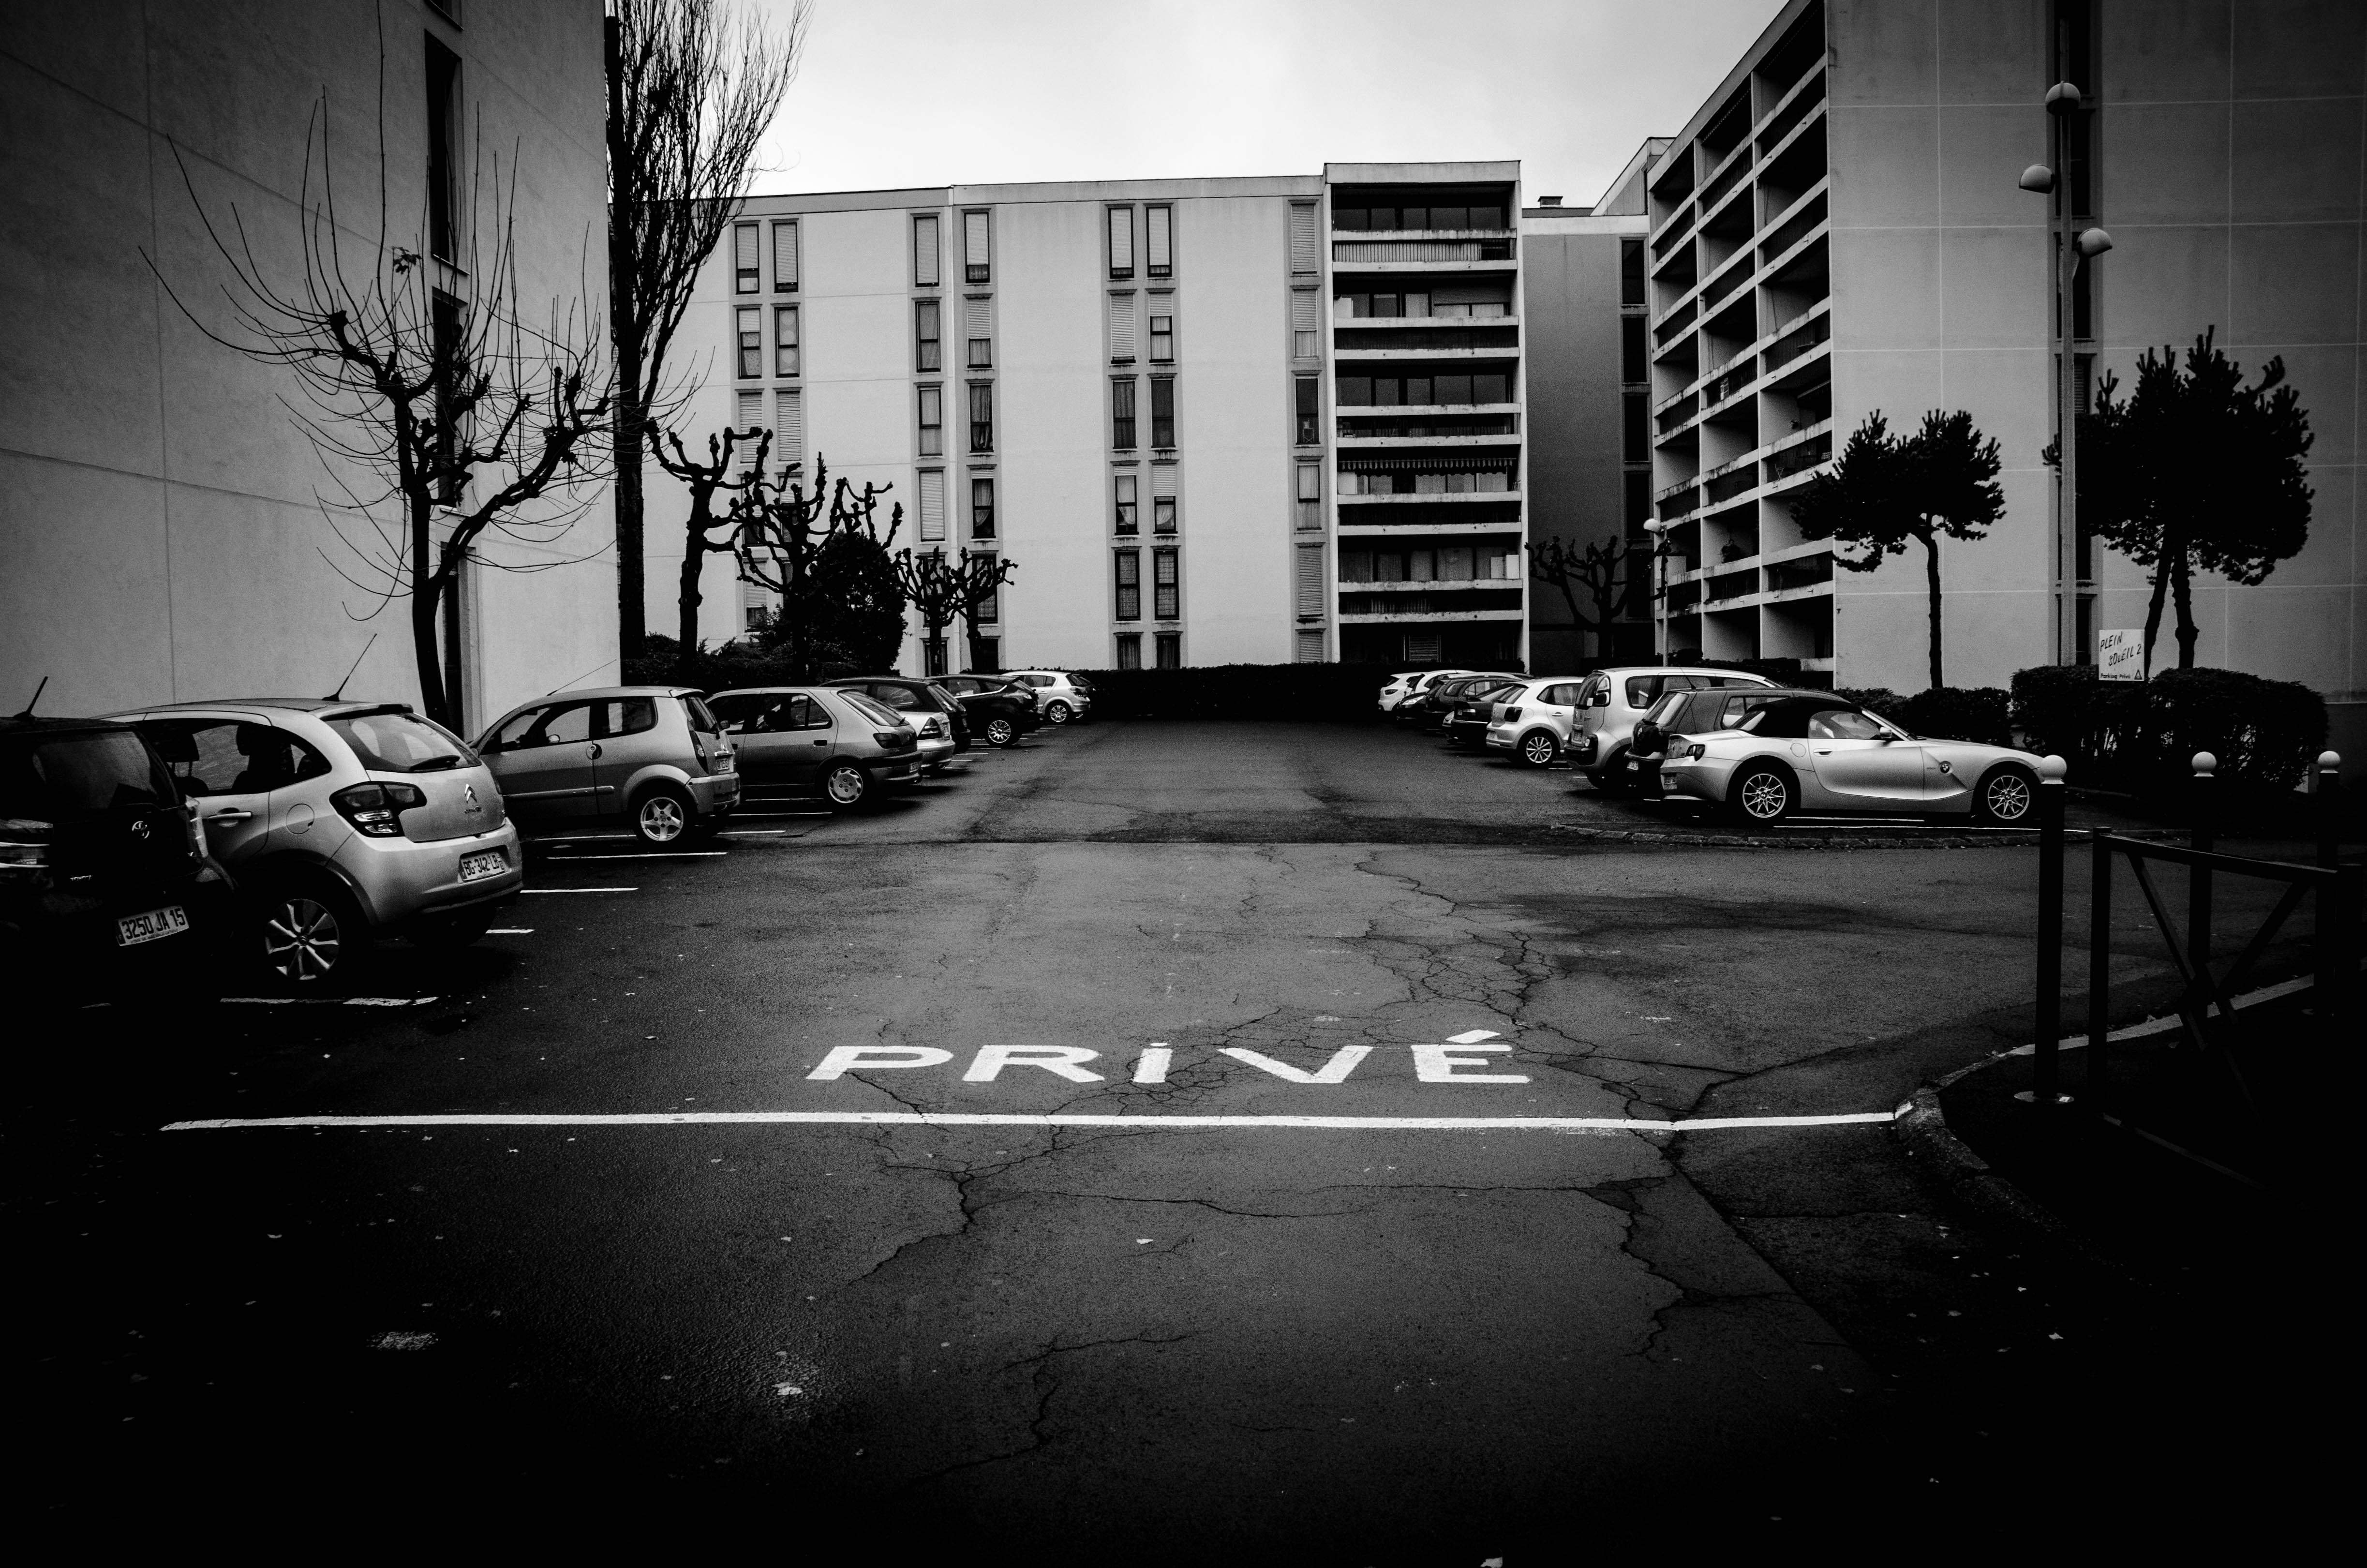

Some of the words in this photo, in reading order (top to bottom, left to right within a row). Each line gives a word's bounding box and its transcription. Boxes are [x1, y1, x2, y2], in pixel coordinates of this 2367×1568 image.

[2100, 631, 2123, 652] PLEIN
[2108, 646, 2134, 666] SOLEIL
[2136, 644, 2142, 655] 2
[122, 916, 154, 940] 3250
[156, 912, 170, 931] JA
[170, 908, 185, 926] 15
